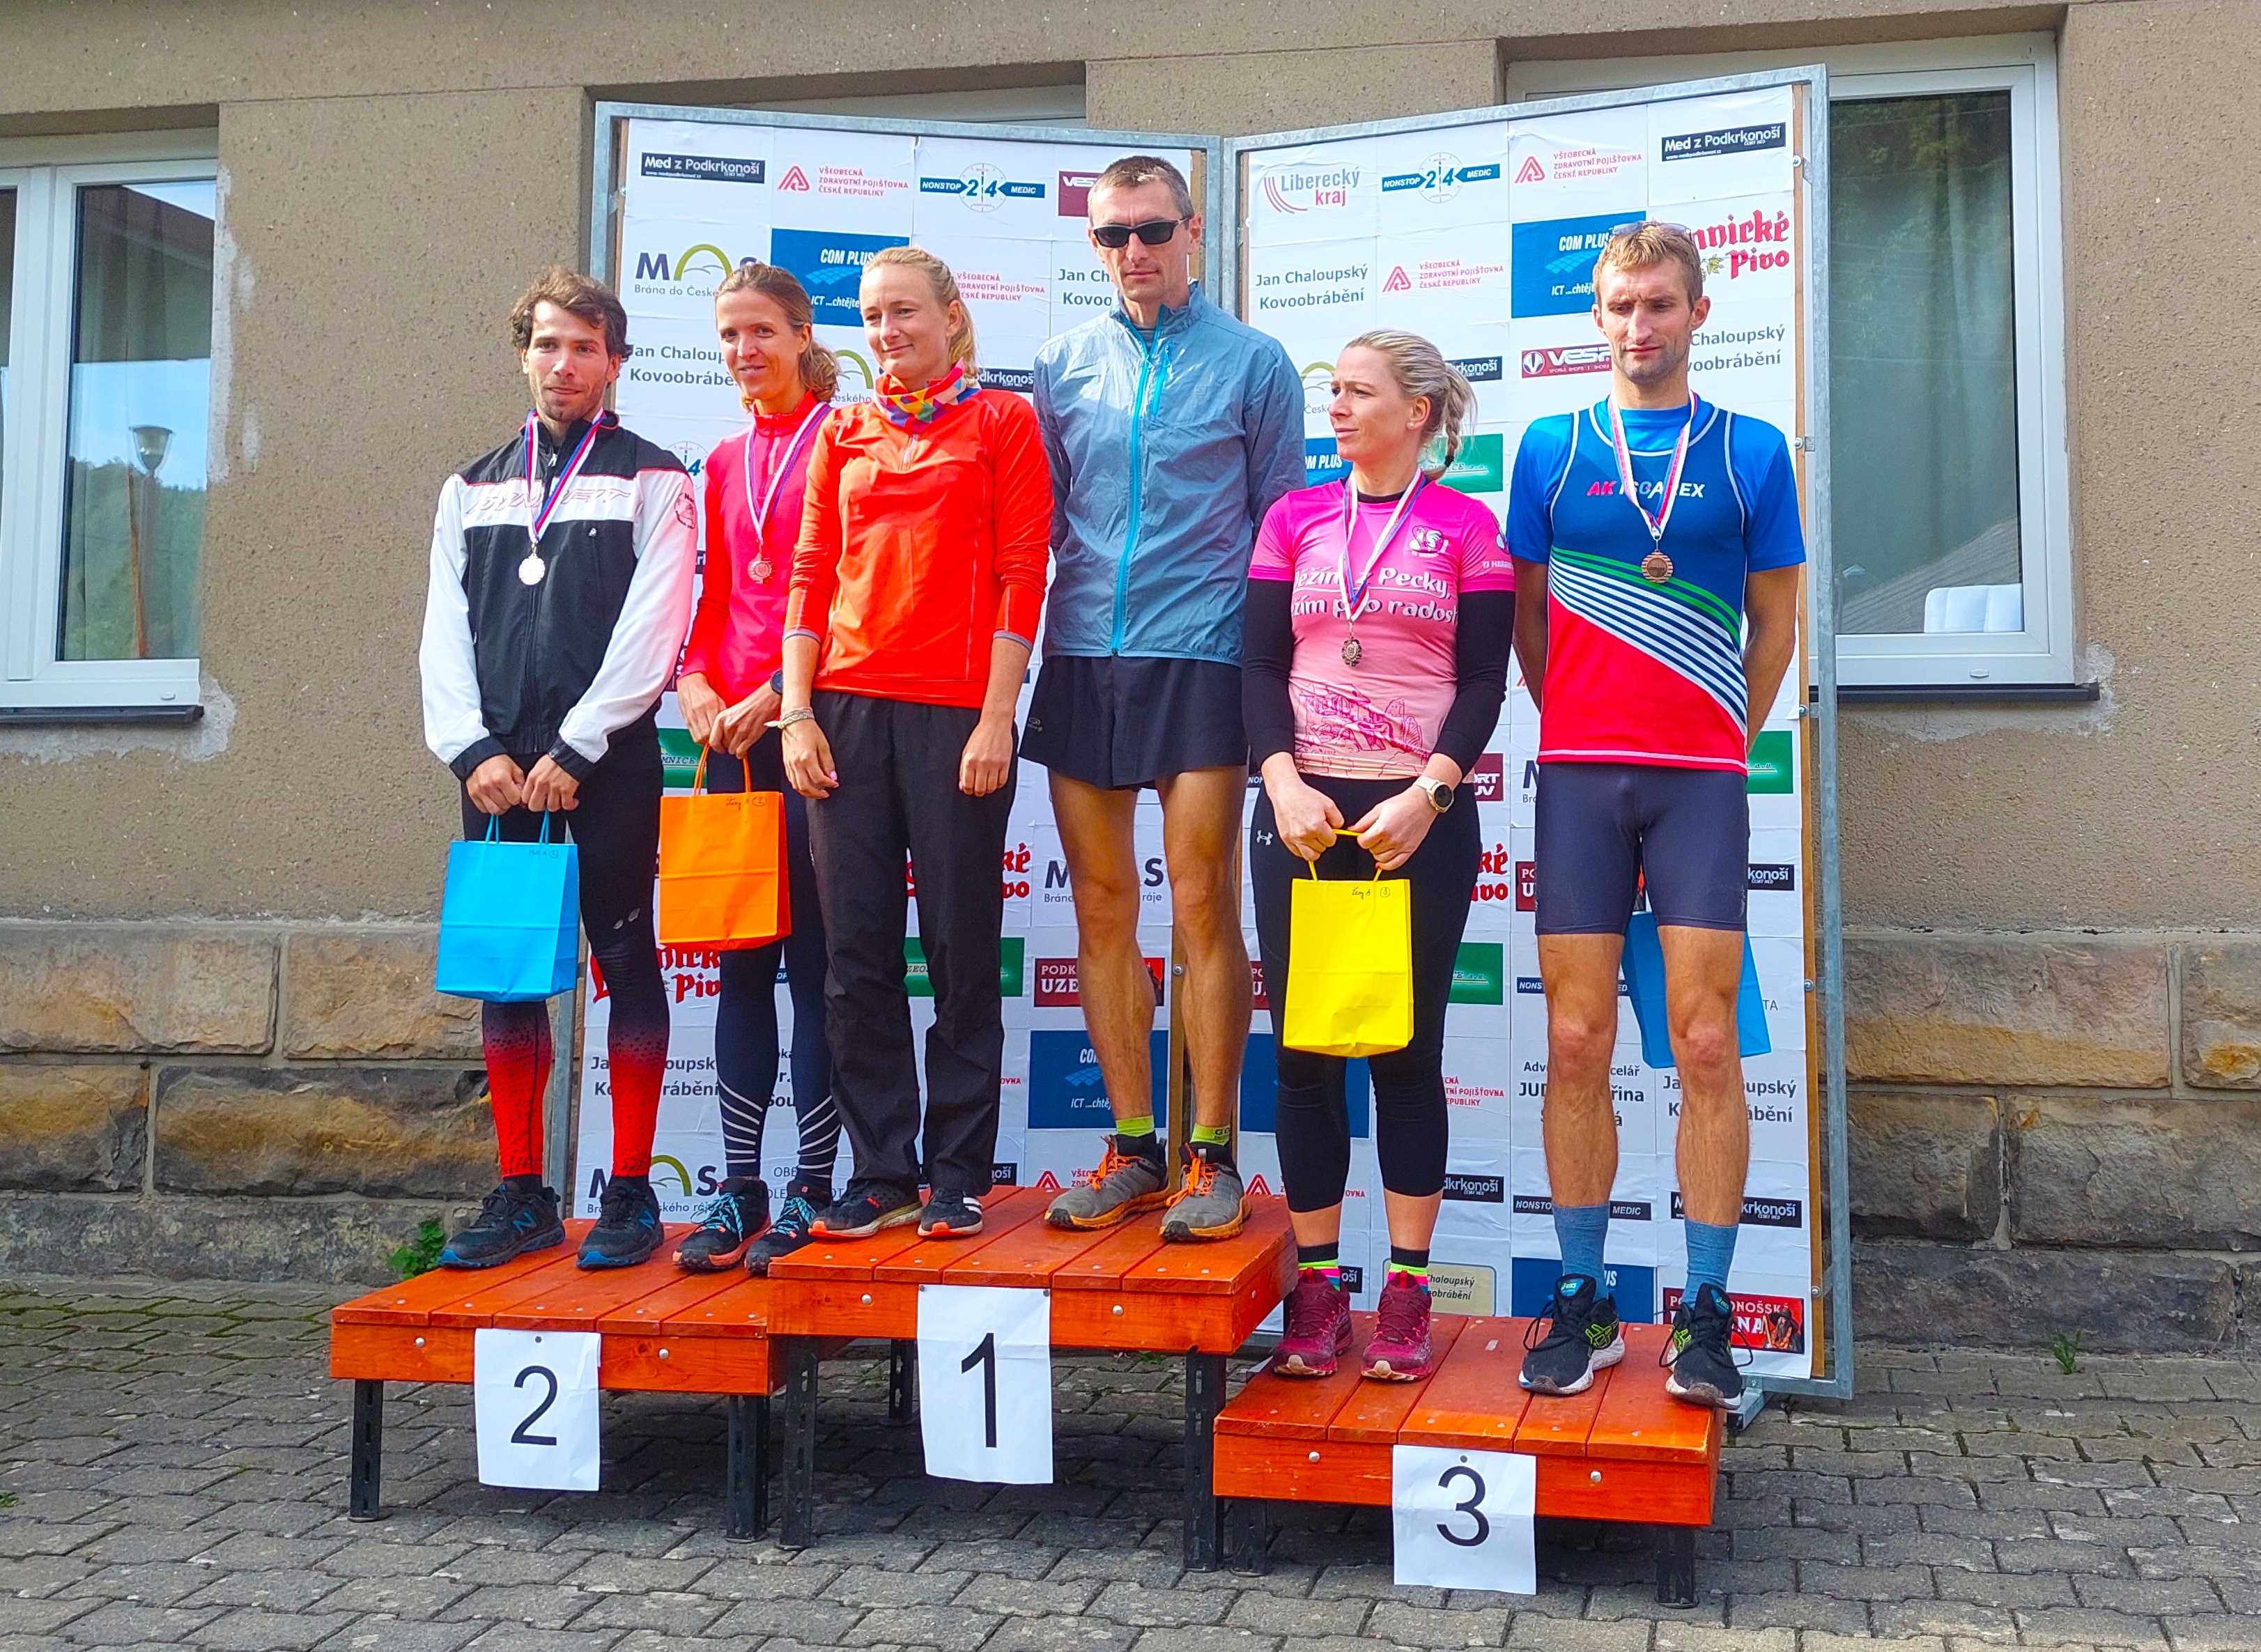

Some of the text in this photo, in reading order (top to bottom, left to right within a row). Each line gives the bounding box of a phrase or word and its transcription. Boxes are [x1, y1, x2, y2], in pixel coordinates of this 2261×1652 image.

[1665, 126, 1780, 151] Med z Podkrkonoší
[1554, 148, 1596, 160] VŠEOBECNÁ
[1554, 154, 1642, 169] ZDRAVOTNÍ POJIŠŤOVNA
[645, 156, 760, 174] Med z Podkrkonoší
[819, 167, 863, 176] VŠEOBECNÁ
[1281, 167, 1359, 191] Liberecký
[1384, 178, 1421, 187] NONSTOP
[1467, 169, 1492, 178] MEDIC
[1554, 167, 1618, 179] ČESKÉ REPUBLIKY
[819, 177, 908, 189] ZDRAVOTNÍ POJIŠŤOVNA
[923, 181, 962, 191] NONSTOP
[844, 188, 884, 196] REPUBLIKY
[1315, 185, 1346, 206] kraj
[1559, 234, 1582, 252] COM
[821, 249, 844, 264] COM
[1725, 247, 1789, 279] Pivo
[1419, 260, 1460, 270] VŠEOBECNÁ
[1419, 265, 1504, 279] ZDRAVOTNÍ POJIŠŤOVNA
[957, 272, 1000, 281] VŠEOBECNÁ
[1058, 270, 1085, 281] Jan
[1256, 263, 1368, 286] Jan Chaloupský
[1001, 284, 1044, 293] POJIŠŤOVNA
[1419, 277, 1481, 288] ČESKÉ REPUBLIKY
[1552, 284, 1594, 295] ICT ...chtěj
[635, 284, 718, 297] Brána do Česk
[982, 293, 1021, 301] REPUBLIKY
[1260, 287, 1364, 309] Kovoobrábění
[811, 295, 825, 306] ICT
[1691, 324, 1785, 346] Chaloupský
[635, 346, 724, 364] an Chalou
[1688, 350, 1781, 372] voobrábění
[1453, 360, 1497, 373] rkonoší
[631, 369, 737, 386] Kovoobráb
[976, 369, 1033, 384] dkrkonoš
[1304, 404, 1329, 414] Česk
[1587, 481, 1616, 496] AK
[466, 488, 631, 514] DYNFIT
[1378, 568, 1451, 599] Pecky,
[1333, 600, 1382, 617] po
[1747, 867, 1789, 880] konoší
[674, 973, 720, 1004] Piv
[591, 1058, 716, 1074] Ja oupsk
[1610, 1065, 1640, 1076] celář
[663, 1081, 719, 1096] rábění
[1459, 1087, 1504, 1097] POJIŠŤOVNA
[1611, 1085, 1644, 1102] řina
[1663, 1076, 1796, 1098] Ja upský
[1071, 1097, 1085, 1109] ICT
[774, 1166, 797, 1178] OBE
[1444, 1178, 1498, 1192] dkrkonoší
[660, 1203, 689, 1212] ského
[1516, 1200, 1641, 1216] NONSTO MEDIC
[1741, 1201, 1796, 1217] krkonoší
[1428, 1290, 1472, 1300] obrábění
[960, 1331, 997, 1449] 1
[511, 1365, 559, 1446] 2
[1436, 1465, 1490, 1546] 3
